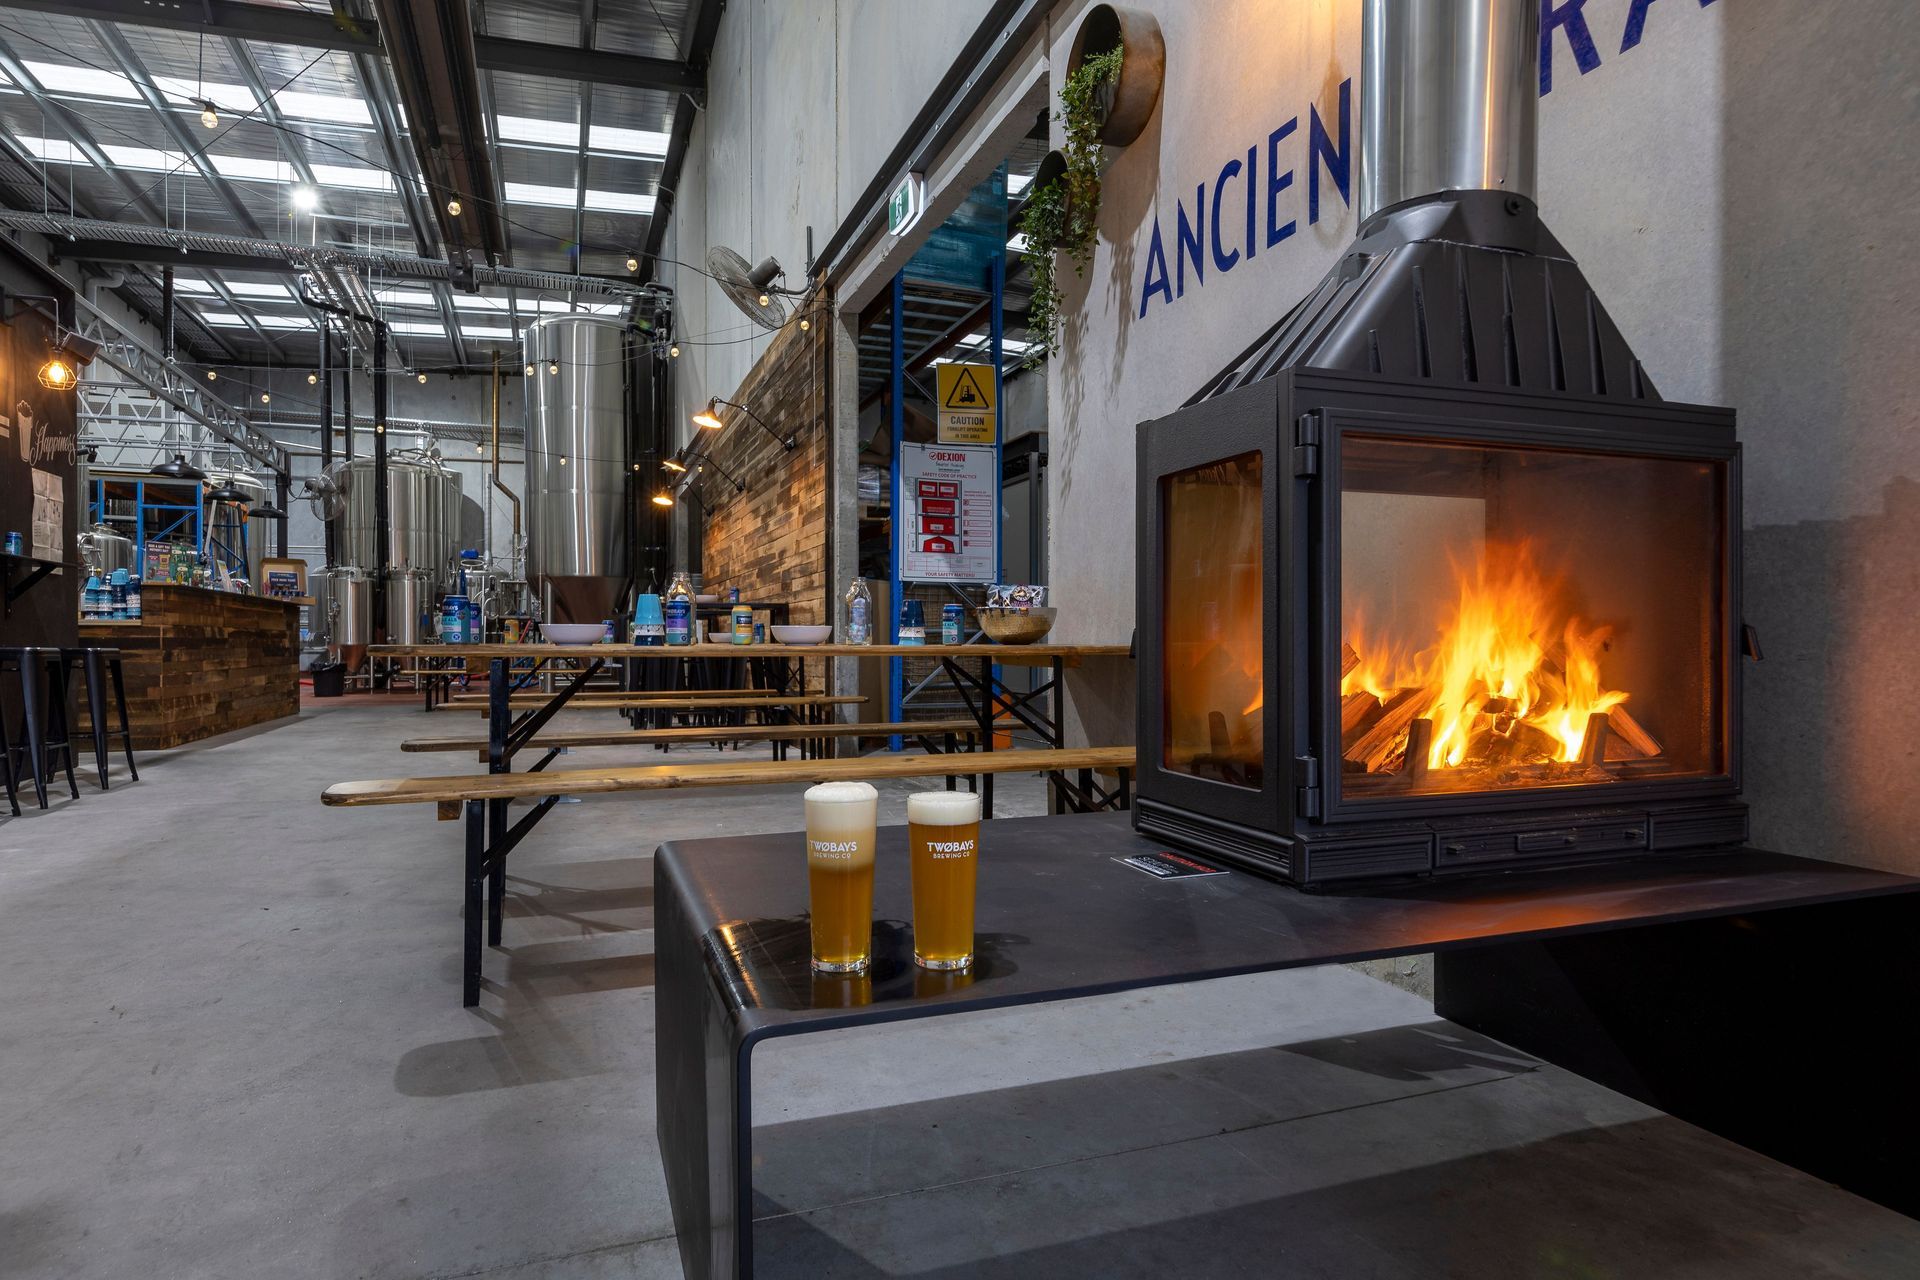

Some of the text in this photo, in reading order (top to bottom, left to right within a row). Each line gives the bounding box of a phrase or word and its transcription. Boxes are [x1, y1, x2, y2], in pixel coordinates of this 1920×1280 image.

[1139, 77, 1351, 320] ANCIEN
[951, 416, 985, 425] CAUTION
[30, 420, 76, 466] Happiness
[937, 452, 966, 462] DEXION
[933, 851, 962, 859] BREWING
